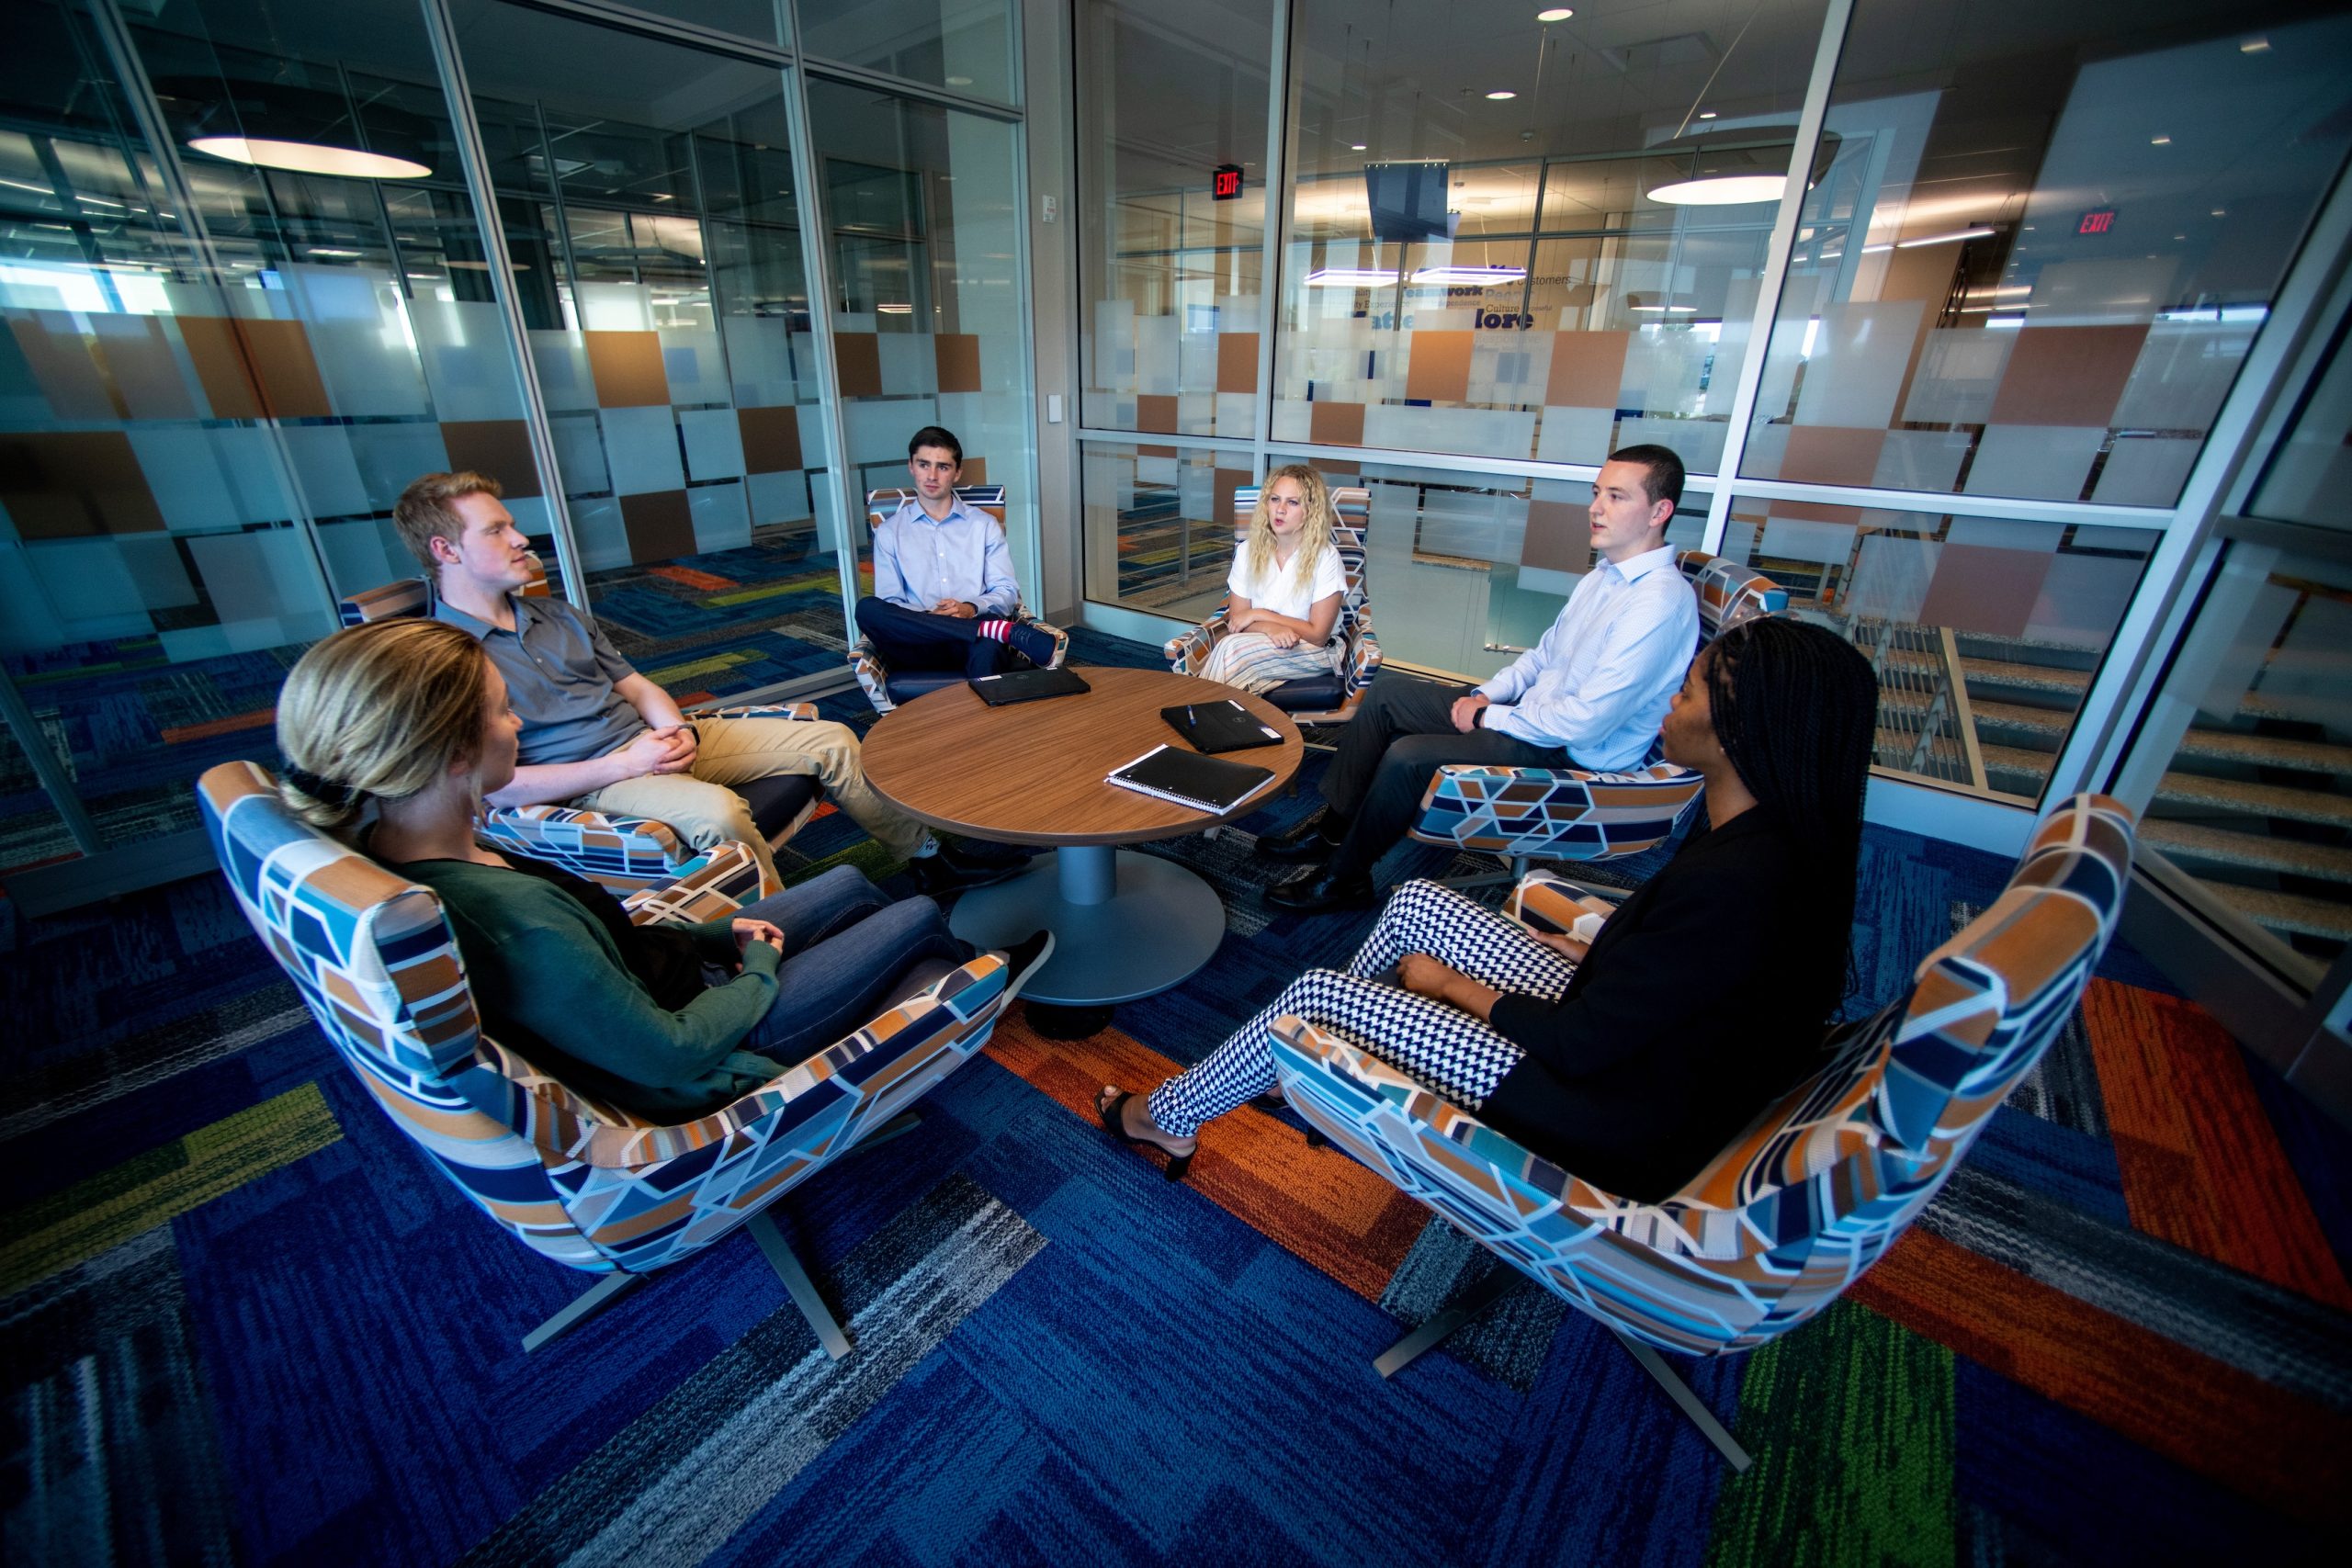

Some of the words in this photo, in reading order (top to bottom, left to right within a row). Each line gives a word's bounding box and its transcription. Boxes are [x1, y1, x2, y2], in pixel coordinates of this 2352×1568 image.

[1216, 172, 1238, 195] EXIT
[2079, 212, 2114, 234] EXIT
[1517, 276, 1572, 287] Cstomers
[1402, 286, 1483, 298] eawork
[1485, 288, 1534, 301] Peope
[1364, 299, 1410, 310] Experiece
[1431, 299, 1481, 310] dependence
[1486, 304, 1521, 313] Culture
[1476, 335, 1542, 348] Responive
